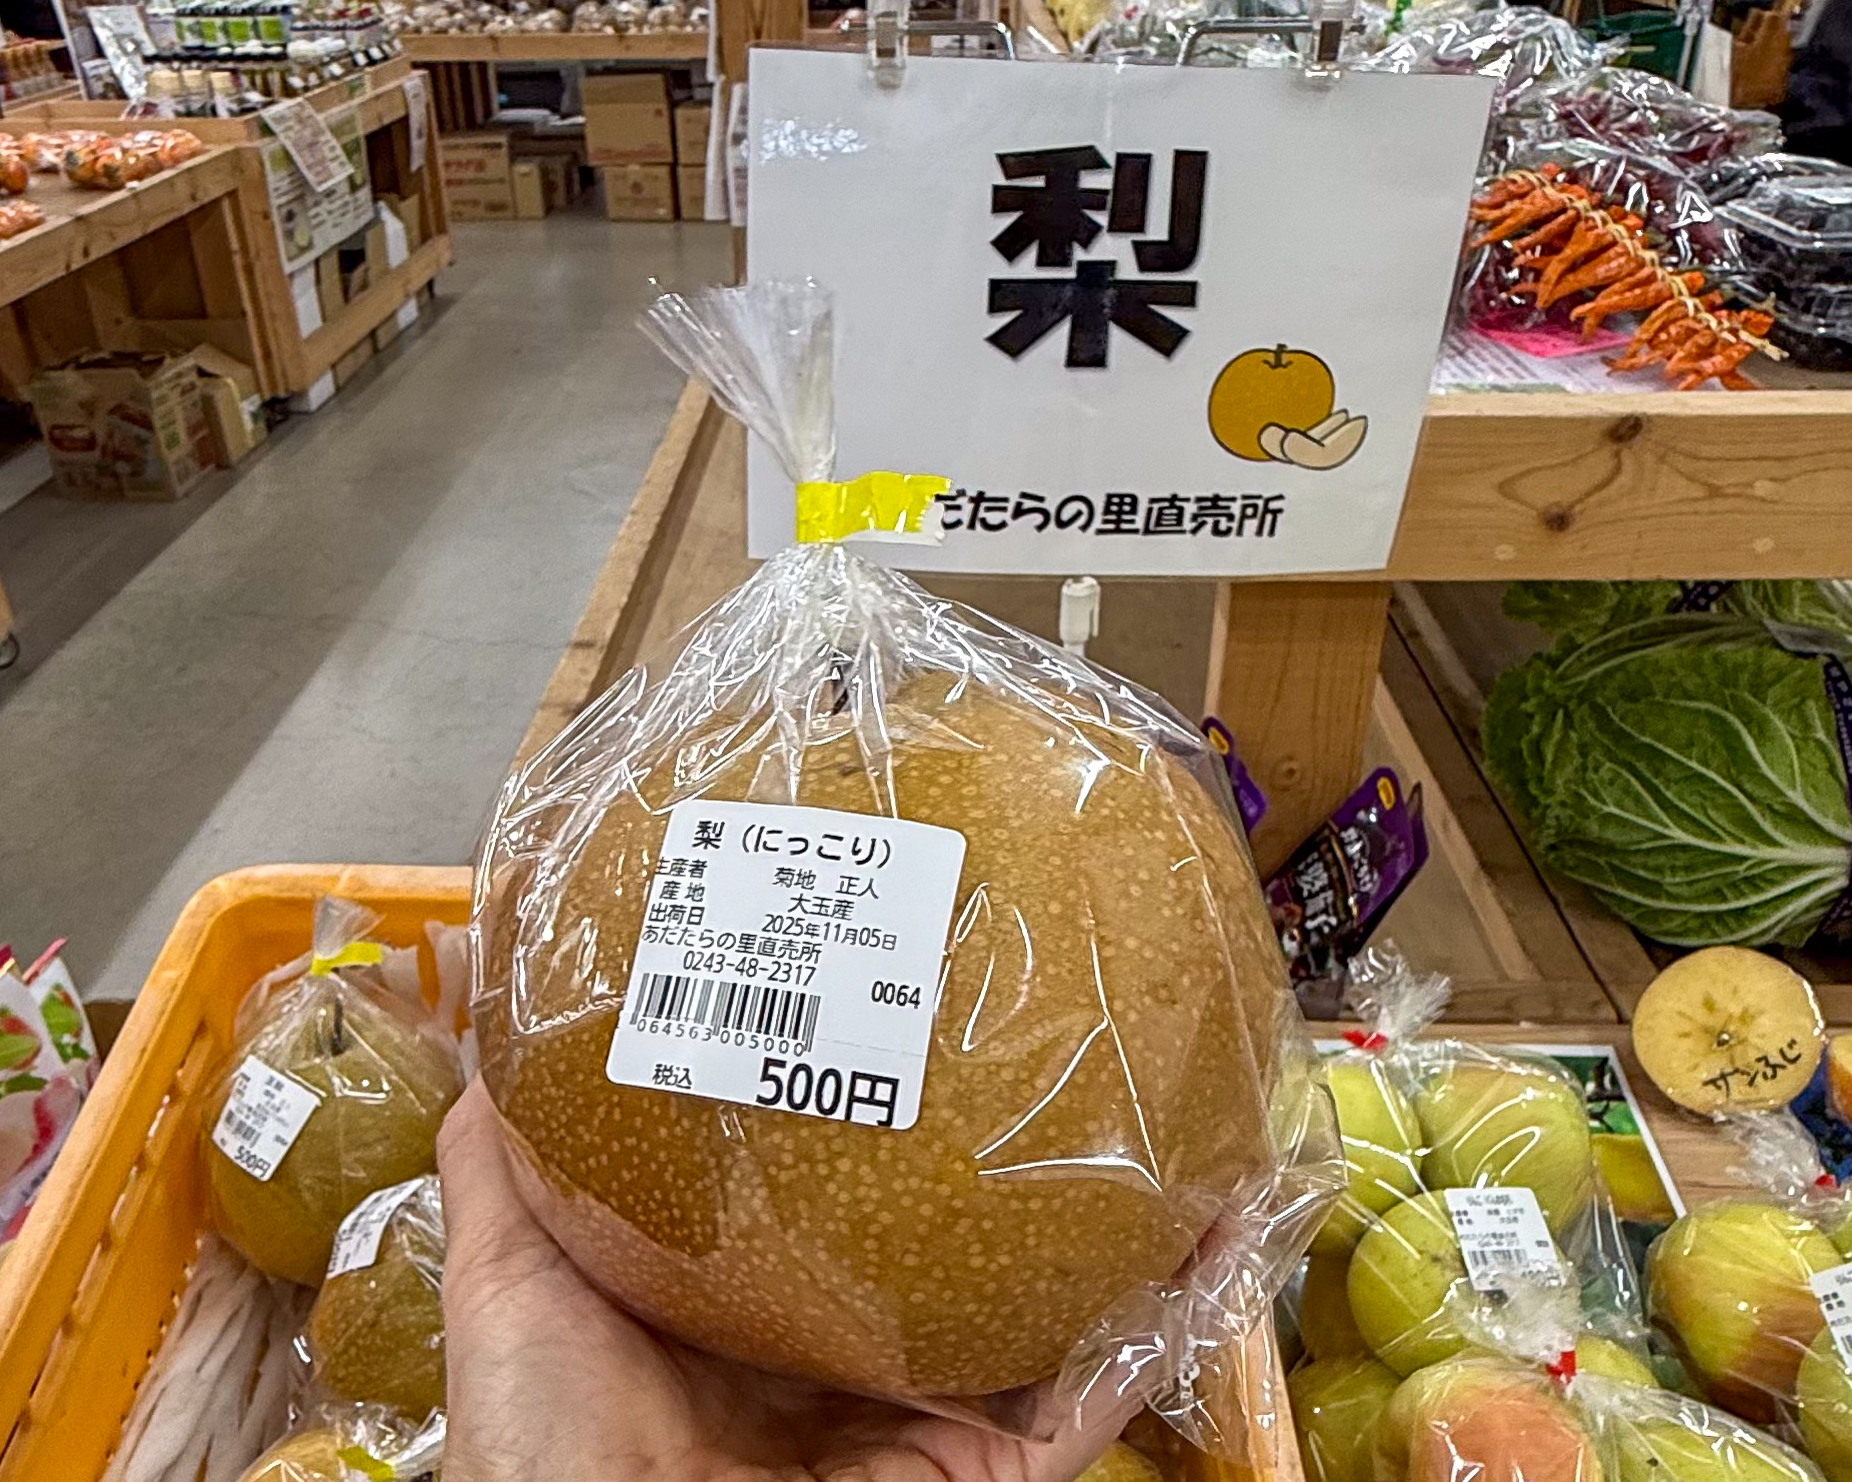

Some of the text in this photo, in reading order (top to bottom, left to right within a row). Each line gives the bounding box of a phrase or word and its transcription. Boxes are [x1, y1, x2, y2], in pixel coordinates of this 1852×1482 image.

[984, 143, 1211, 370] 梨
[934, 488, 1285, 538] だたらの里直売所
[655, 857, 879, 900] 生産者 菊地 正人
[648, 902, 897, 951] 出荷日 2025年11月05日
[787, 893, 855, 921] 大玉産
[641, 925, 823, 965] あだたらの里直売所
[683, 950, 817, 987] 0243-48-2317
[871, 980, 922, 1010] 0064
[652, 1056, 901, 1128] 税込 500円
